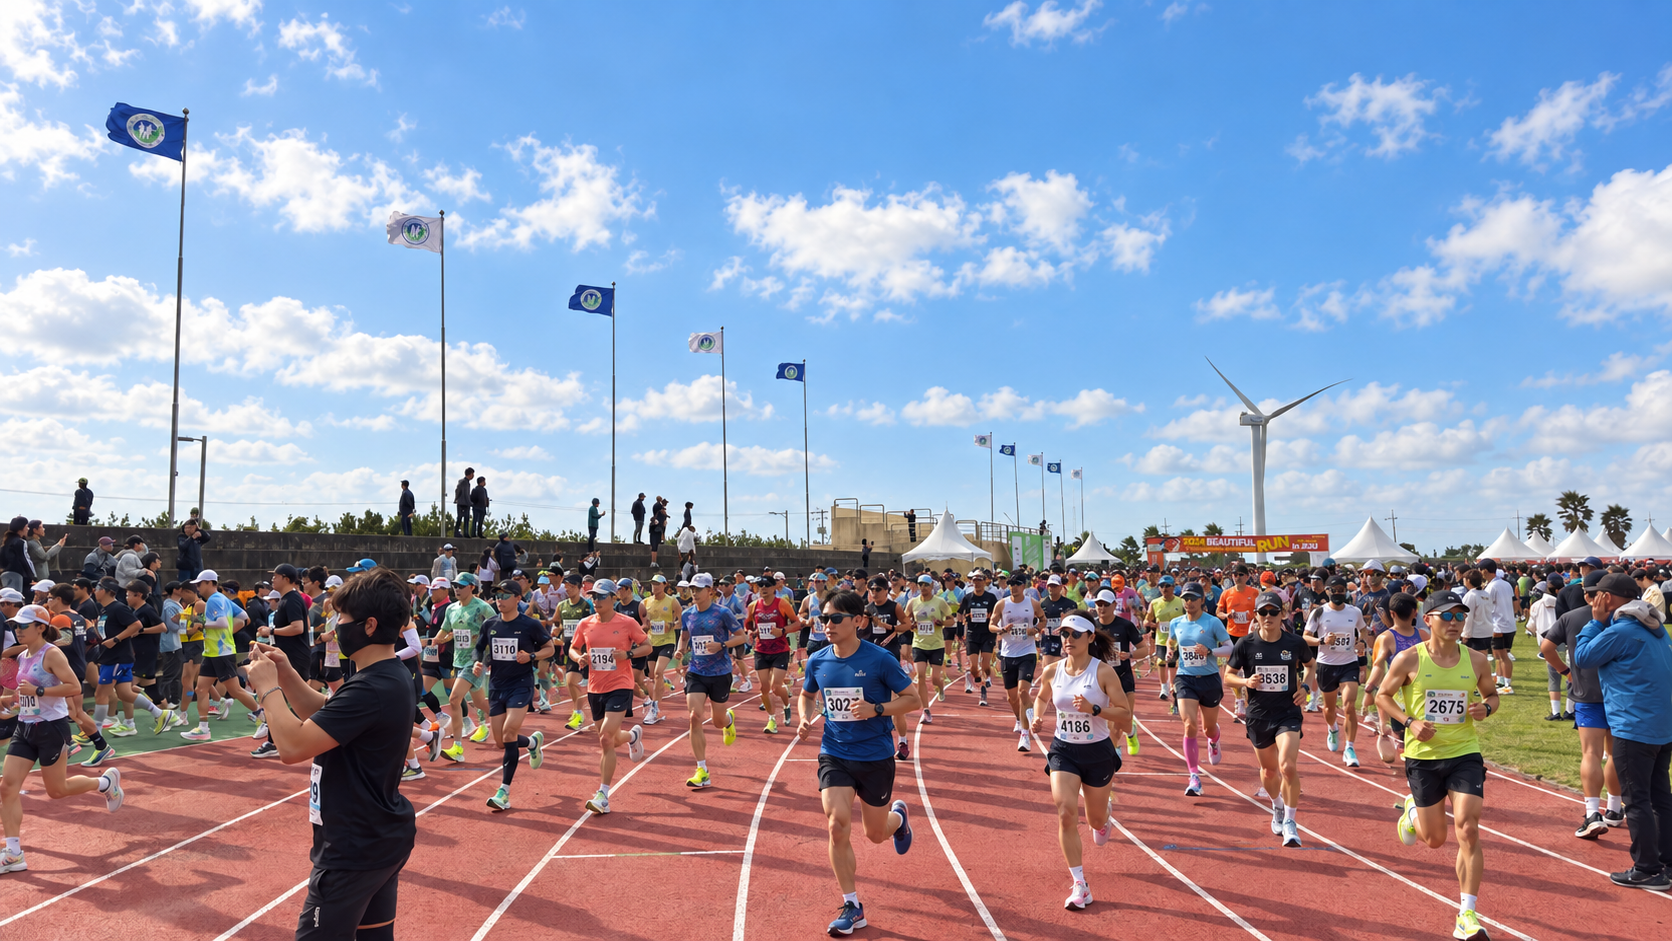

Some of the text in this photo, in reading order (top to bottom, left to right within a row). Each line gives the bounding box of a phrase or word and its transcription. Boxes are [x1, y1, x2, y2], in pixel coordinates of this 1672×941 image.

[1206, 537, 1256, 547] BEAUTIFUL
[1256, 535, 1289, 552] RUN
[493, 644, 516, 655] 3110
[592, 654, 614, 664] 2194
[1429, 700, 1464, 714] 2675
[1061, 720, 1091, 733] 4186
